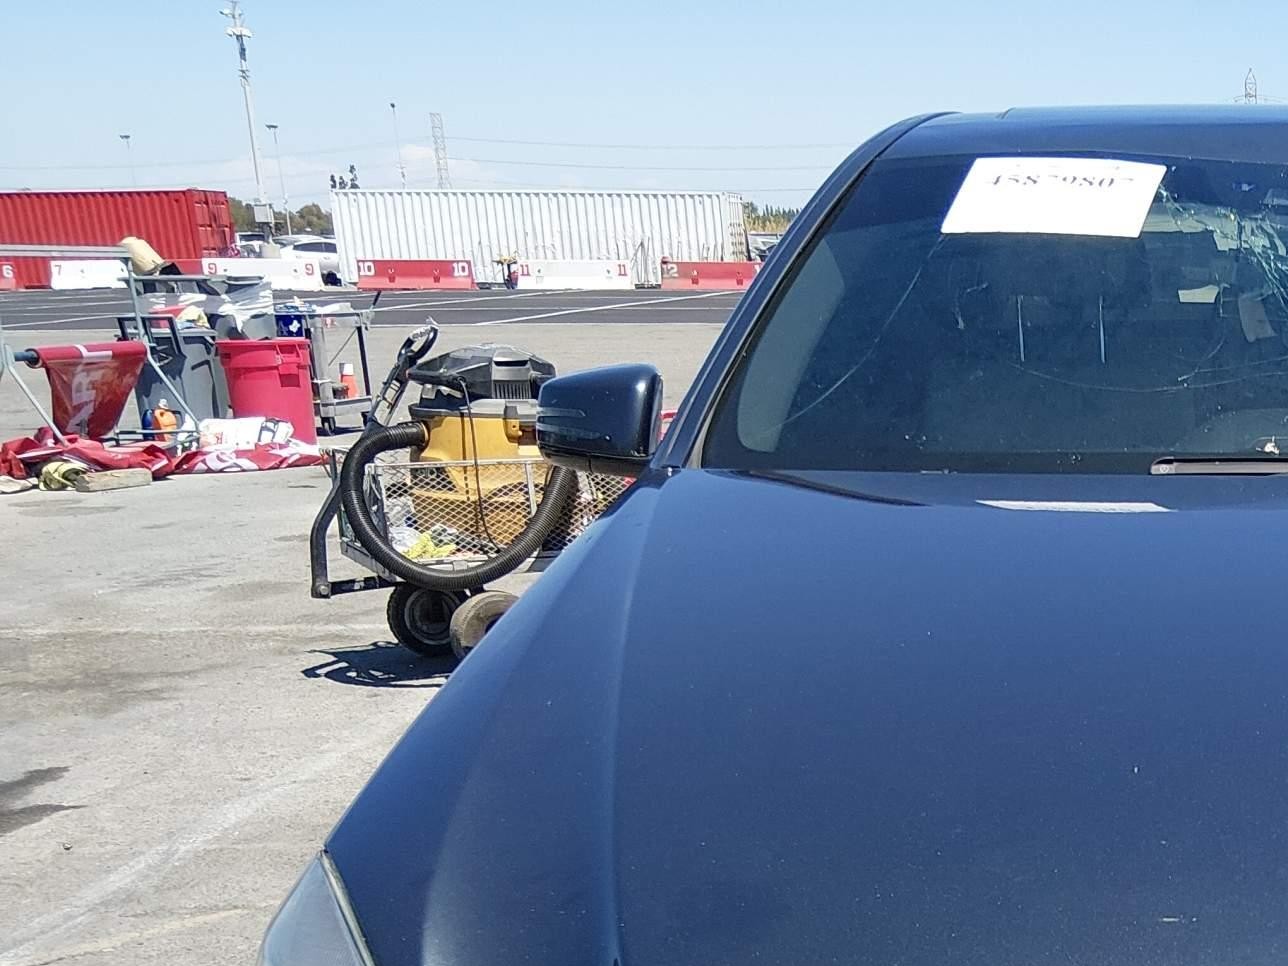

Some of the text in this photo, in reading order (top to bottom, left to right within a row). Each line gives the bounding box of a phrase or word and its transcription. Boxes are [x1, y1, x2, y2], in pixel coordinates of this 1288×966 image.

[2, 265, 13, 279] 6
[54, 264, 63, 276] 7
[208, 262, 217, 275] 9
[305, 263, 314, 276] 9
[358, 262, 376, 276] 10
[452, 262, 469, 276] 10
[520, 264, 531, 277] 11
[618, 264, 628, 277] 11
[662, 264, 679, 278] 12
